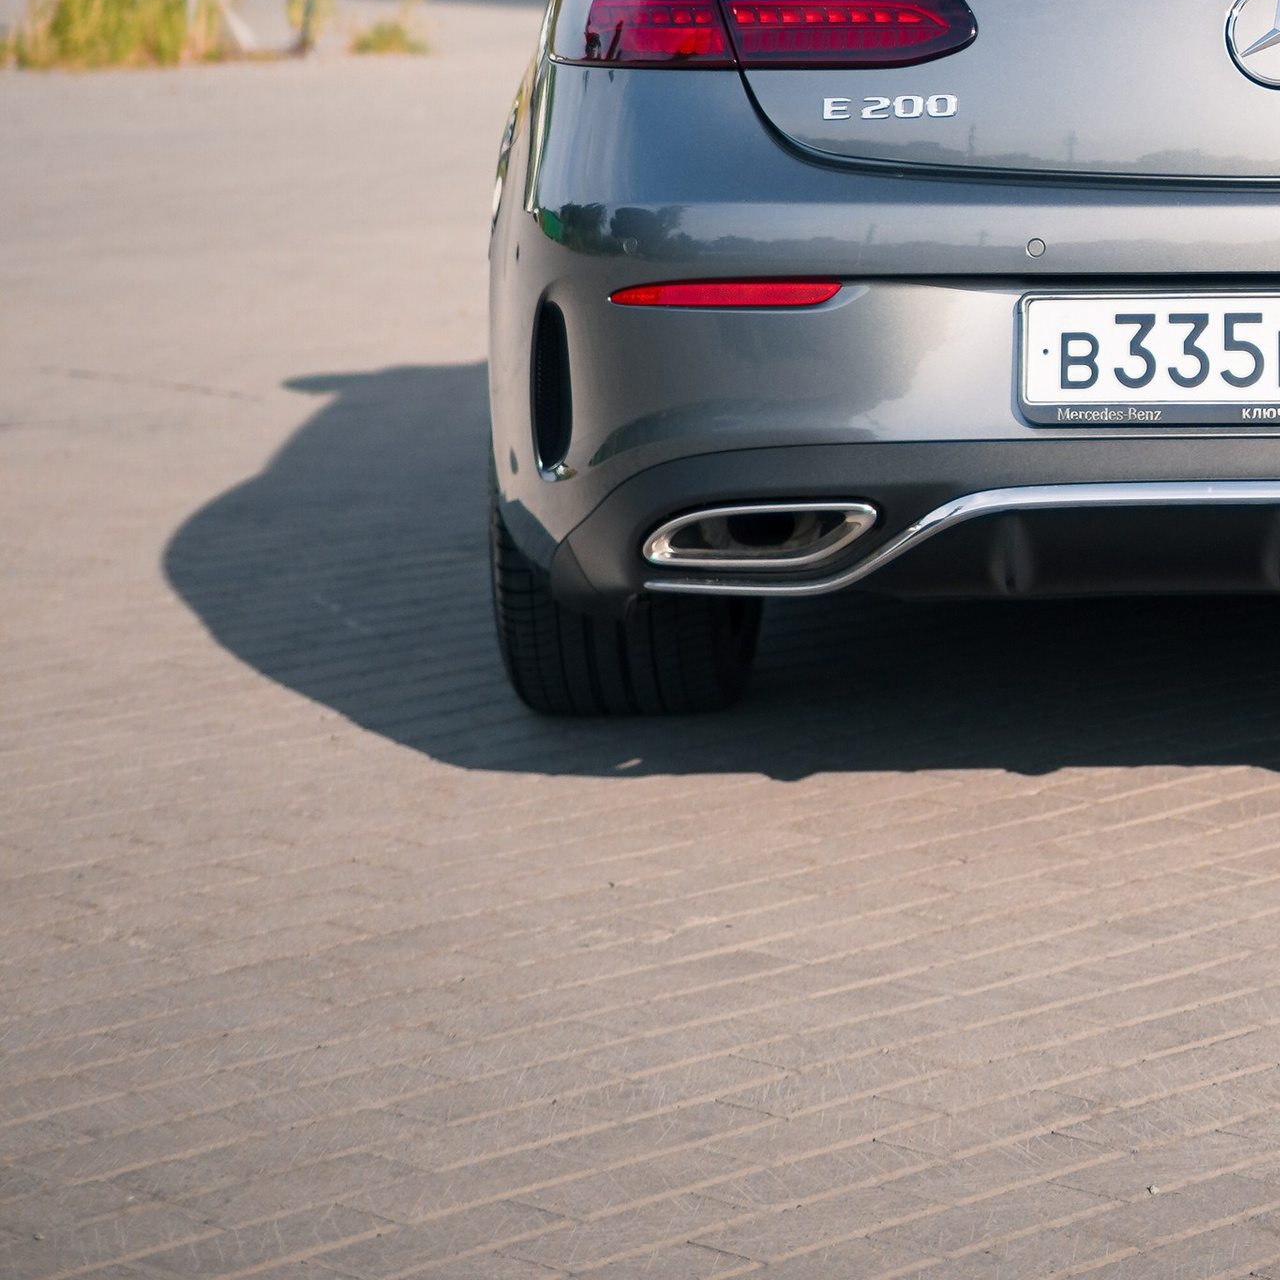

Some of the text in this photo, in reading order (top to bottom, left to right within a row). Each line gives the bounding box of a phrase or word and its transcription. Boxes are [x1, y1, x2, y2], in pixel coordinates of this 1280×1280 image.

[822, 94, 958, 120] E 200
[1057, 407, 1162, 421] Mercedes-Benz
